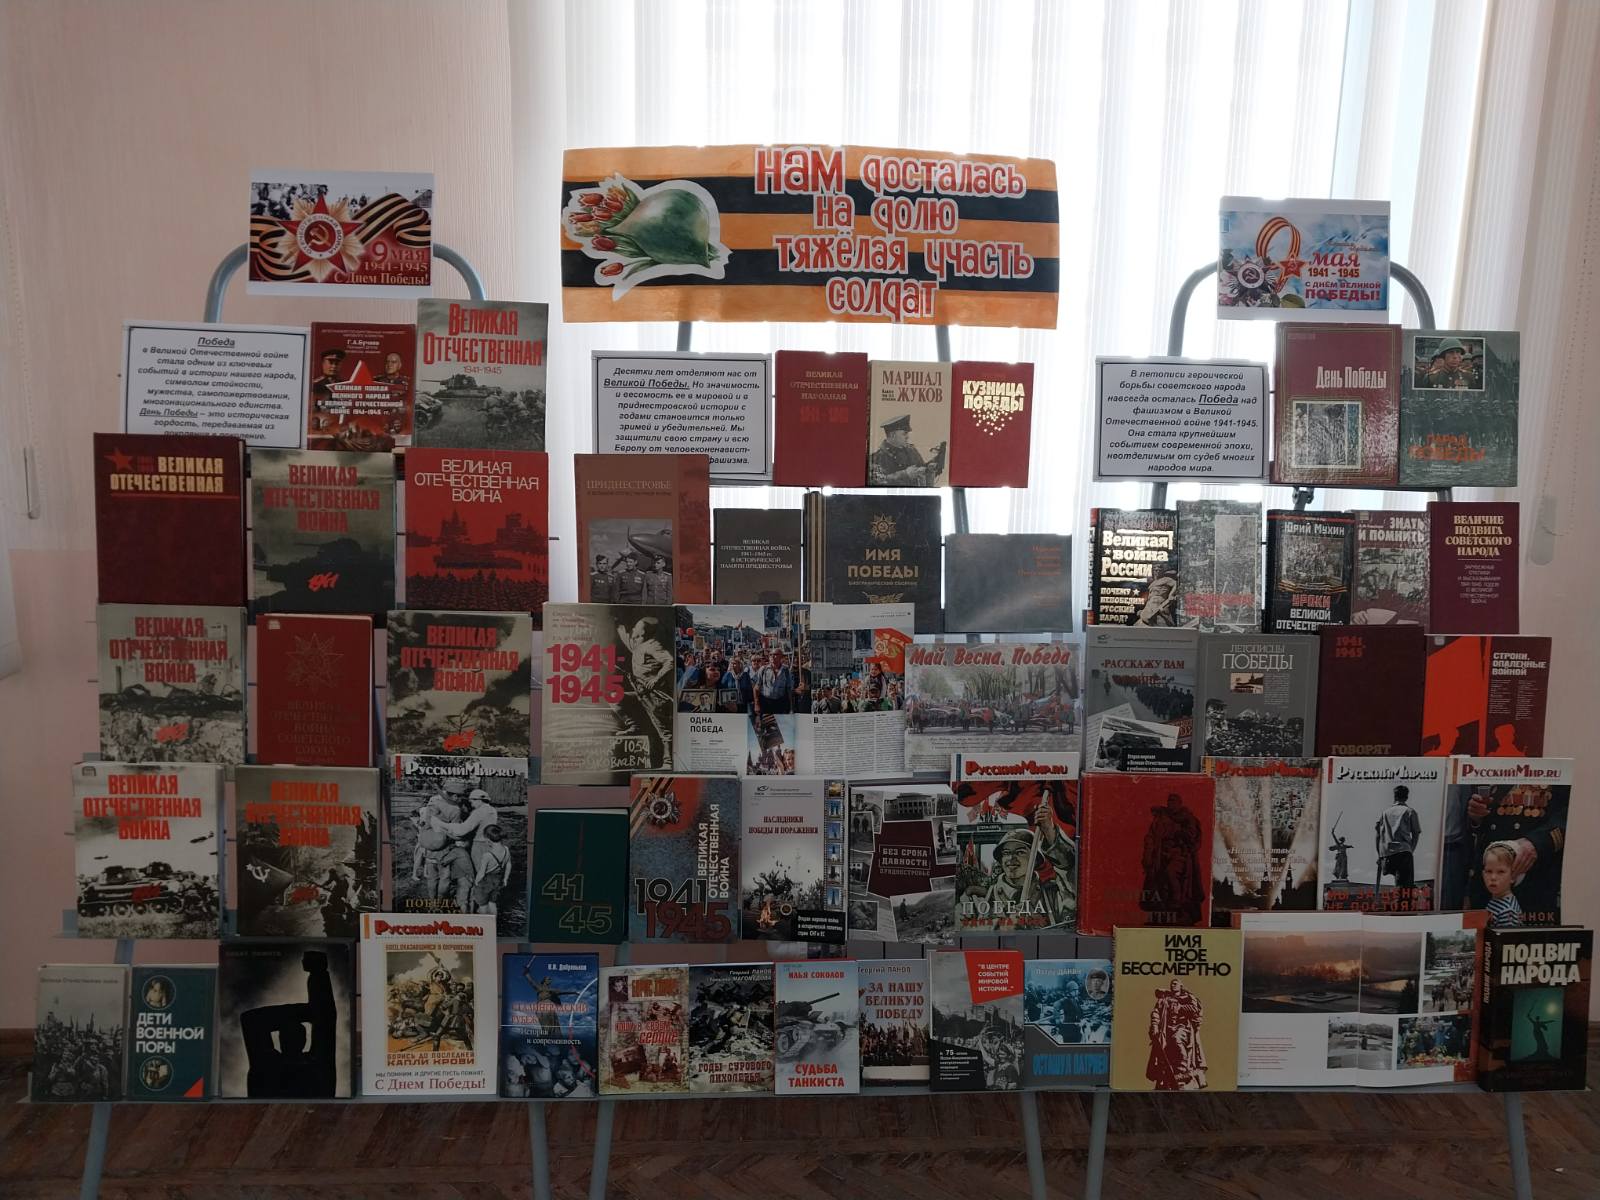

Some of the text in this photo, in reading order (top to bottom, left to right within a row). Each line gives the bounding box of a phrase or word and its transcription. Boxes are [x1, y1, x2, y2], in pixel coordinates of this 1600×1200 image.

[861, 155, 1026, 198] досталась
[815, 195, 957, 233] на долю
[371, 242, 425, 260] 9 мая
[774, 229, 1033, 280] тяжёлая участь
[364, 262, 428, 272] 1941-1945
[1308, 269, 1360, 278] 1941 1945
[335, 272, 429, 285] С Днем Победы!
[827, 277, 938, 322] солдат
[1305, 289, 1381, 303] ПОБЕДЫ!
[448, 303, 518, 336] ВЕЛИКАЯ
[198, 337, 235, 348] Победа
[423, 332, 542, 367] ОТЕЧЕСТВЕННАЯ
[805, 370, 843, 380] ВЕЛИКАЯ
[882, 370, 943, 387] МАРШАЛ
[1316, 366, 1388, 390] День Победы
[604, 379, 646, 388] Великой
[648, 379, 689, 389] Победы.
[790, 380, 859, 390] ОТЕЧЕСТВЕННАЯ
[963, 380, 1024, 397] КУЗНИЦА
[1120, 381, 1245, 391] борьбы советского народа
[899, 386, 943, 403] ЖУКОВ
[1108, 395, 1148, 403] навсегда
[1199, 394, 1238, 405] Победа
[964, 395, 1024, 412] ПОБЕДЫ
[1105, 418, 1181, 426] Отечественной
[1214, 419, 1258, 427] 1941-1945.
[1128, 429, 1145, 437] Она
[1179, 430, 1236, 439] крупнейшим
[1162, 442, 1221, 450] современной
[158, 456, 224, 474] ВЕЛИКАЯ
[441, 458, 512, 475] ВЕЛИКАЯ
[289, 464, 358, 486] ВЕЛИКАЯ
[414, 472, 540, 491] ОТЕЧЕСТВЕННАЯ
[110, 473, 224, 493] ОТЕЧЕСТВЕННАЯ
[587, 479, 672, 490] ПРИДНЕСТРОВЬЕ
[264, 487, 380, 511] ОТЕЧЕСТВЕННАЯ
[452, 486, 502, 504] ВОЙНА
[297, 508, 348, 532] ВОЙНА
[1389, 516, 1425, 530] ЗНАТЬ
[1453, 515, 1504, 525] ВЕЛИЧИЕ
[1358, 530, 1425, 542] И ПОМНИТЬ
[1455, 526, 1502, 536] ПОДВИГА
[1446, 536, 1512, 546] СОВЕТСКОГО
[864, 548, 900, 561] ИМЯ
[1458, 546, 1500, 557] НАРОДА
[848, 564, 919, 578] ПОБЕДЫ
[1292, 594, 1330, 608] УРОКИ
[1100, 606, 1135, 614] РУССКИЙ
[1290, 608, 1330, 620] ВЕЛИКОЙ
[1100, 615, 1128, 624] НАРОД?
[134, 616, 205, 638] ВЕЛИКАЯ
[426, 624, 497, 647] ВЕЛИКАЯ
[109, 639, 228, 660] ОТЕЧЕСТВЕННАЯ
[909, 646, 1071, 666] Май. Весна. Победа
[1230, 644, 1285, 654] ЛЕТОПИСЦЫ
[401, 646, 520, 672] ОТЕЧЕСТВЕННАЯ
[544, 643, 625, 672] 1941-
[1222, 652, 1295, 672] ПОБЕДЫ
[1493, 652, 1530, 661] СТРОКИ,
[144, 661, 196, 683] ВОЙНА
[1164, 660, 1184, 670] ВАМ
[1492, 660, 1547, 670] ОПАЛЕННЫЕ
[1492, 668, 1527, 676] ВОЙНОЙ
[433, 672, 486, 692] ВОЙНА
[545, 674, 625, 704] 1945
[690, 716, 713, 726] ОДНА
[690, 725, 724, 734] ПОБЕДА
[1331, 744, 1392, 756] ГОВОРЯТ
[108, 774, 178, 796] ВЕЛИКАЯ
[270, 783, 339, 803] ВЕЛИКАЯ
[83, 797, 202, 819] ОТЕЧЕСТВЕННАЯ
[764, 815, 804, 824] НАСЛЕДНИКИ
[118, 820, 170, 841] ВОЙНА
[748, 826, 772, 834] ПОБЕДЫ
[696, 822, 708, 877] ВЕЛИКАЯ
[708, 804, 720, 898] ОТЕЧЕСТВЕННАЯ
[882, 848, 928, 858] БЕЗ СРОКА
[882, 857, 928, 868] ДАВНОСТИ
[720, 856, 730, 899] ВОЙНА
[540, 872, 585, 901] 41
[635, 878, 708, 916] 1941
[558, 905, 613, 936] 45
[646, 901, 732, 940] 1945
[1164, 934, 1202, 948] ИМЯ
[1165, 948, 1208, 962] ТВОЕ
[1502, 943, 1581, 964] ПОДВИГ
[810, 971, 845, 979] СОКОЛОВ
[1121, 962, 1232, 976] БЕССМЕРТНО
[1500, 964, 1581, 986] НАРОДА
[868, 982, 924, 993] ЗА НАШУ
[865, 996, 924, 1006] ВЕЛИКУЮ
[136, 1012, 172, 1027] ДЕТИ
[876, 1008, 924, 1020] ПОБЕДУ
[136, 1026, 204, 1040] ВОЕННОЙ
[136, 1040, 176, 1054] ПОРЫ
[698, 1061, 772, 1073] ГОДЫ СУРОВОГО
[795, 1063, 838, 1076] СУДЬБА
[710, 1072, 761, 1083] ЛИХОЛЕТЬЯ
[788, 1078, 845, 1088] ТАНКИСТА
[375, 1078, 486, 1092] С Днем Победы!
